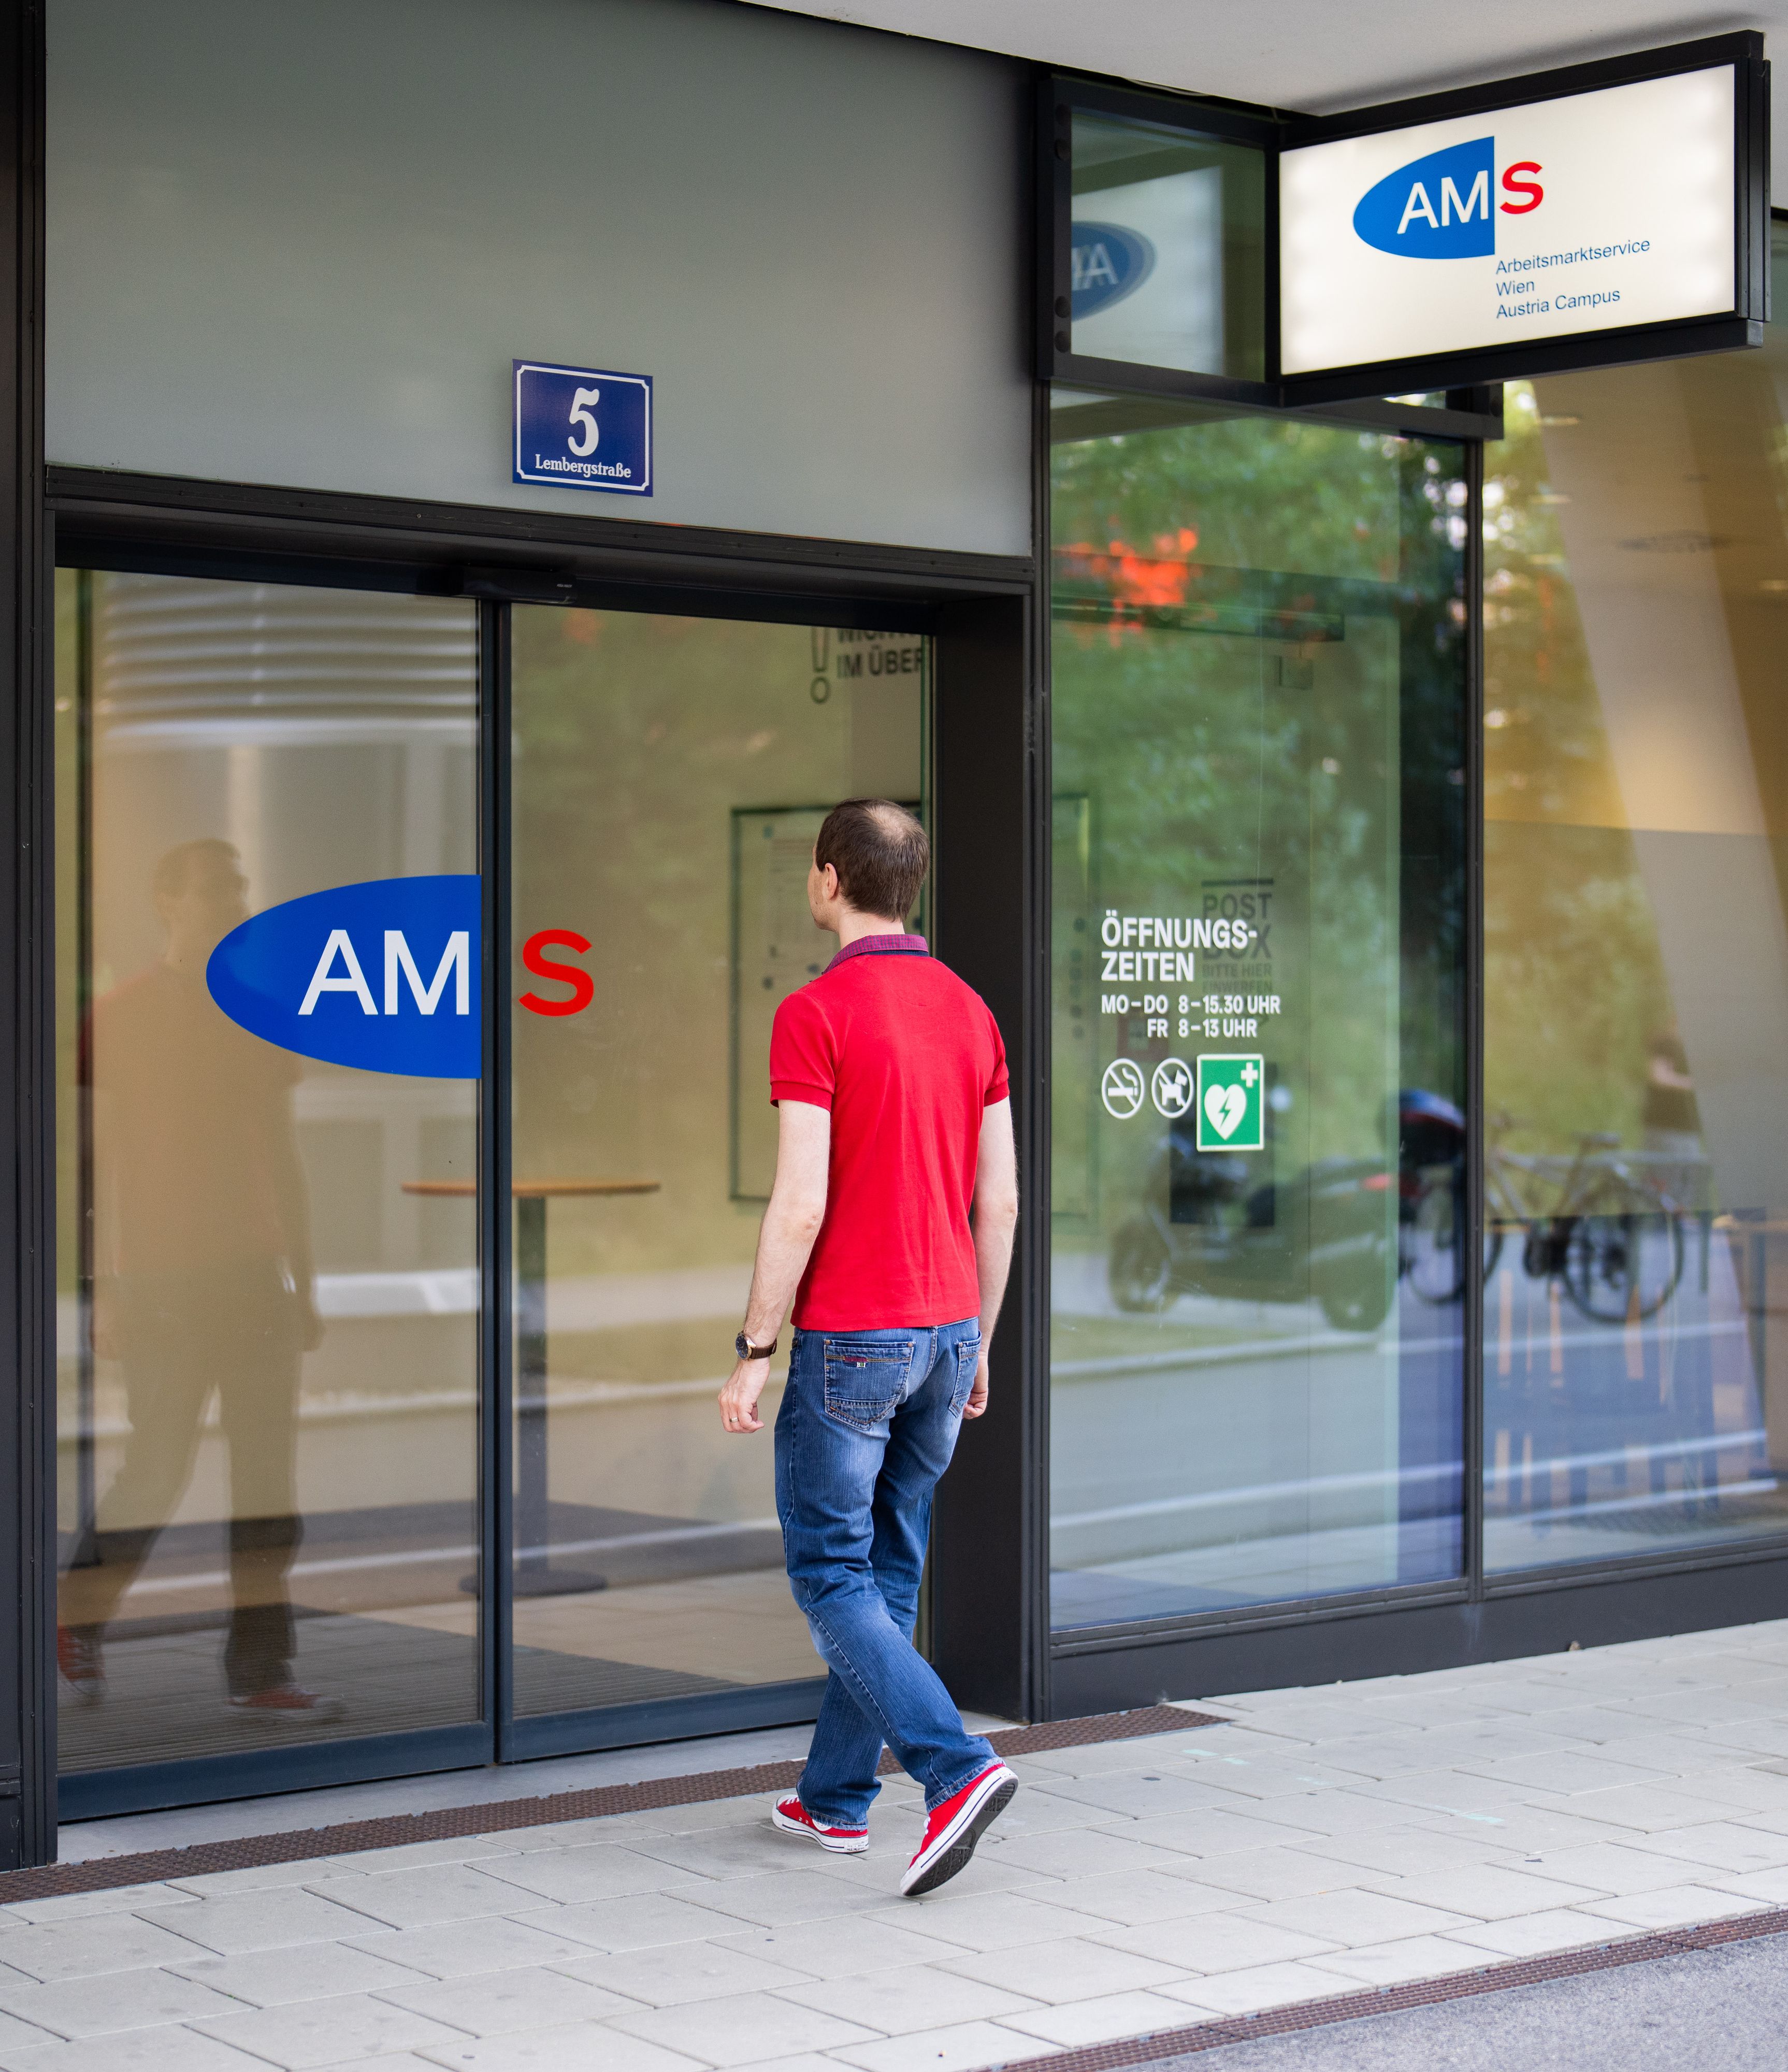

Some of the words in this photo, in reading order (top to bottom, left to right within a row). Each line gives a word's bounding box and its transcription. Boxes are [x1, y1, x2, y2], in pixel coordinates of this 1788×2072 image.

[1396, 161, 1544, 235] AMS
[1495, 239, 1650, 275] Arbeitsmarktservice
[1495, 280, 1535, 296] Wien
[1496, 298, 1550, 319] Austria
[1555, 290, 1621, 310] Campus
[568, 387, 600, 456] 5
[535, 453, 631, 478] Lembergstraße
[1203, 891, 1273, 921] POST
[1101, 910, 1258, 949] ÖFFNUNGS-
[1101, 952, 1194, 982] ZEITEN
[1247, 995, 1281, 1014] UHR
[1147, 1018, 1168, 1038] FR
[1222, 1018, 1257, 1038] UHR
